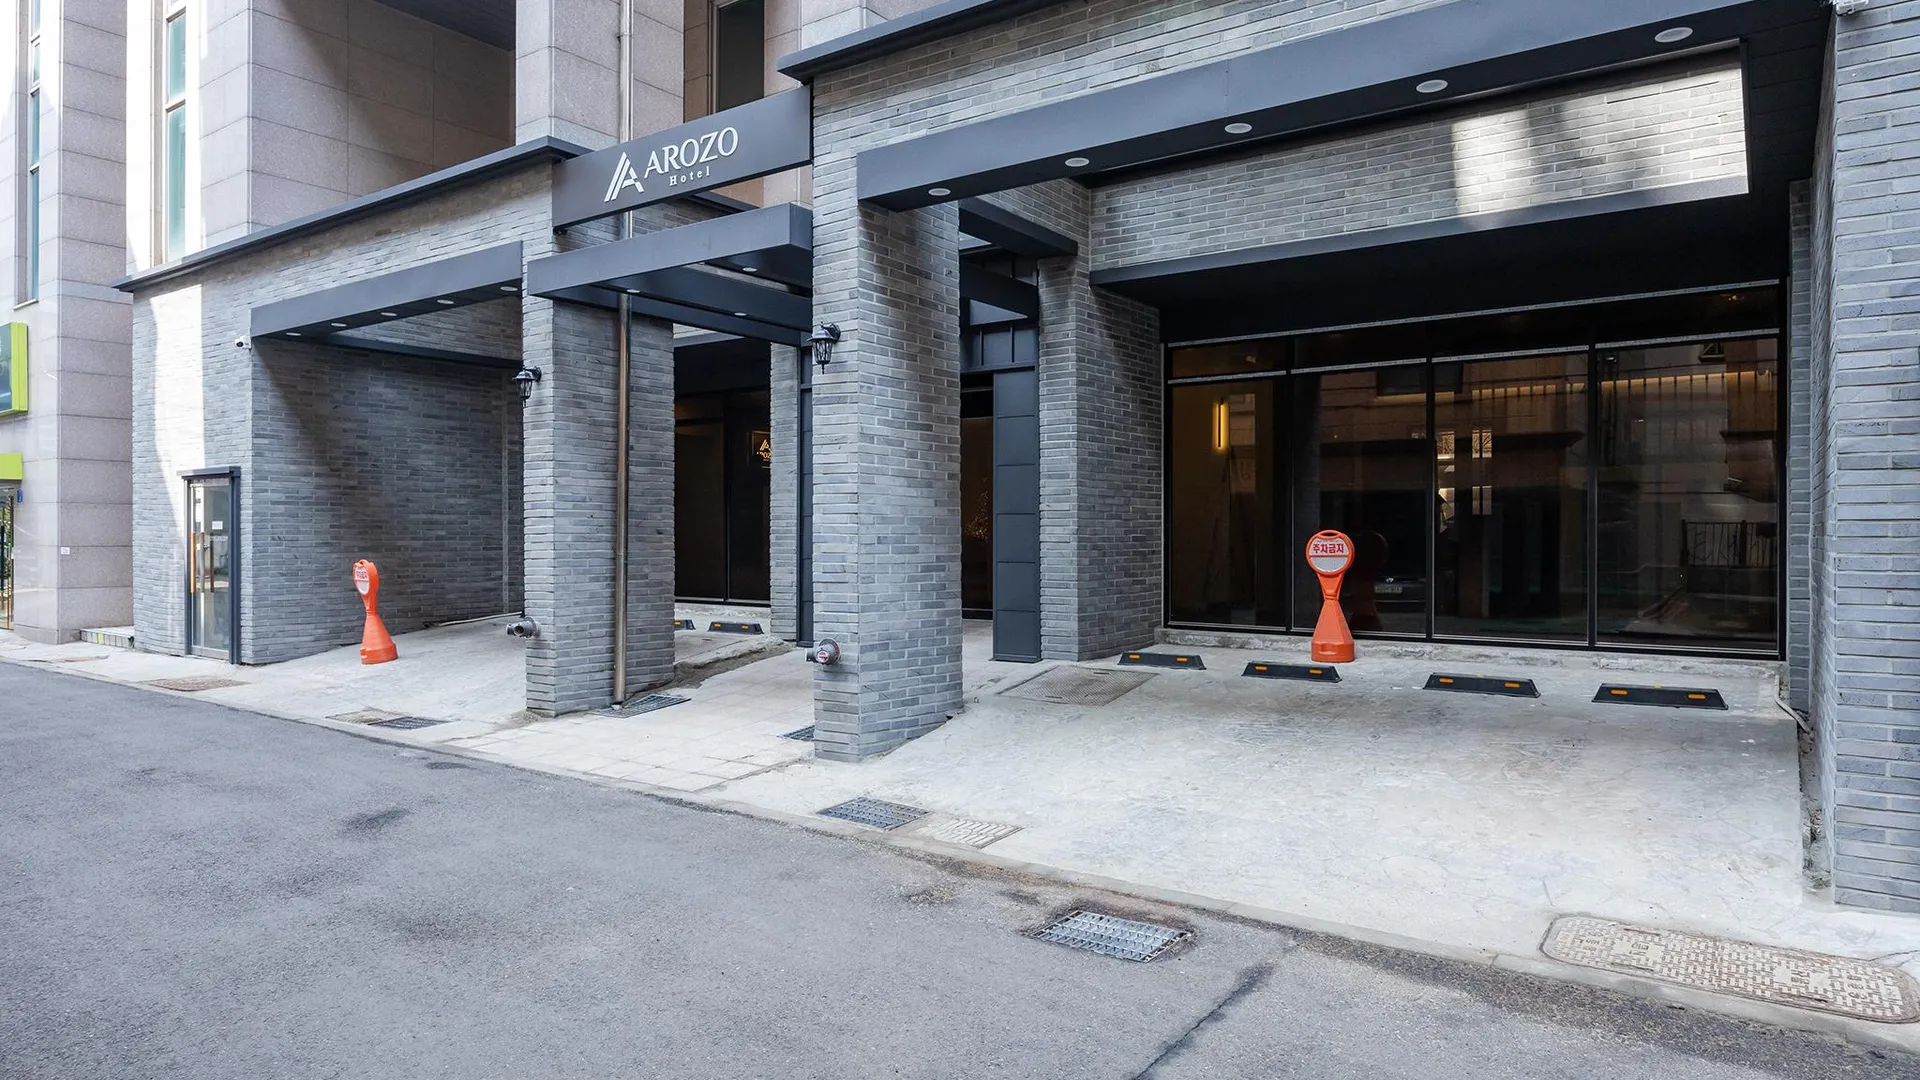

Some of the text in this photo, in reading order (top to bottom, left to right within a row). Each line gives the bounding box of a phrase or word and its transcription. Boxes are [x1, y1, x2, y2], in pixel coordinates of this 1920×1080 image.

[644, 126, 738, 178] AROZO
[669, 165, 710, 186] Hotel
[1313, 543, 1344, 553] 주차금지
